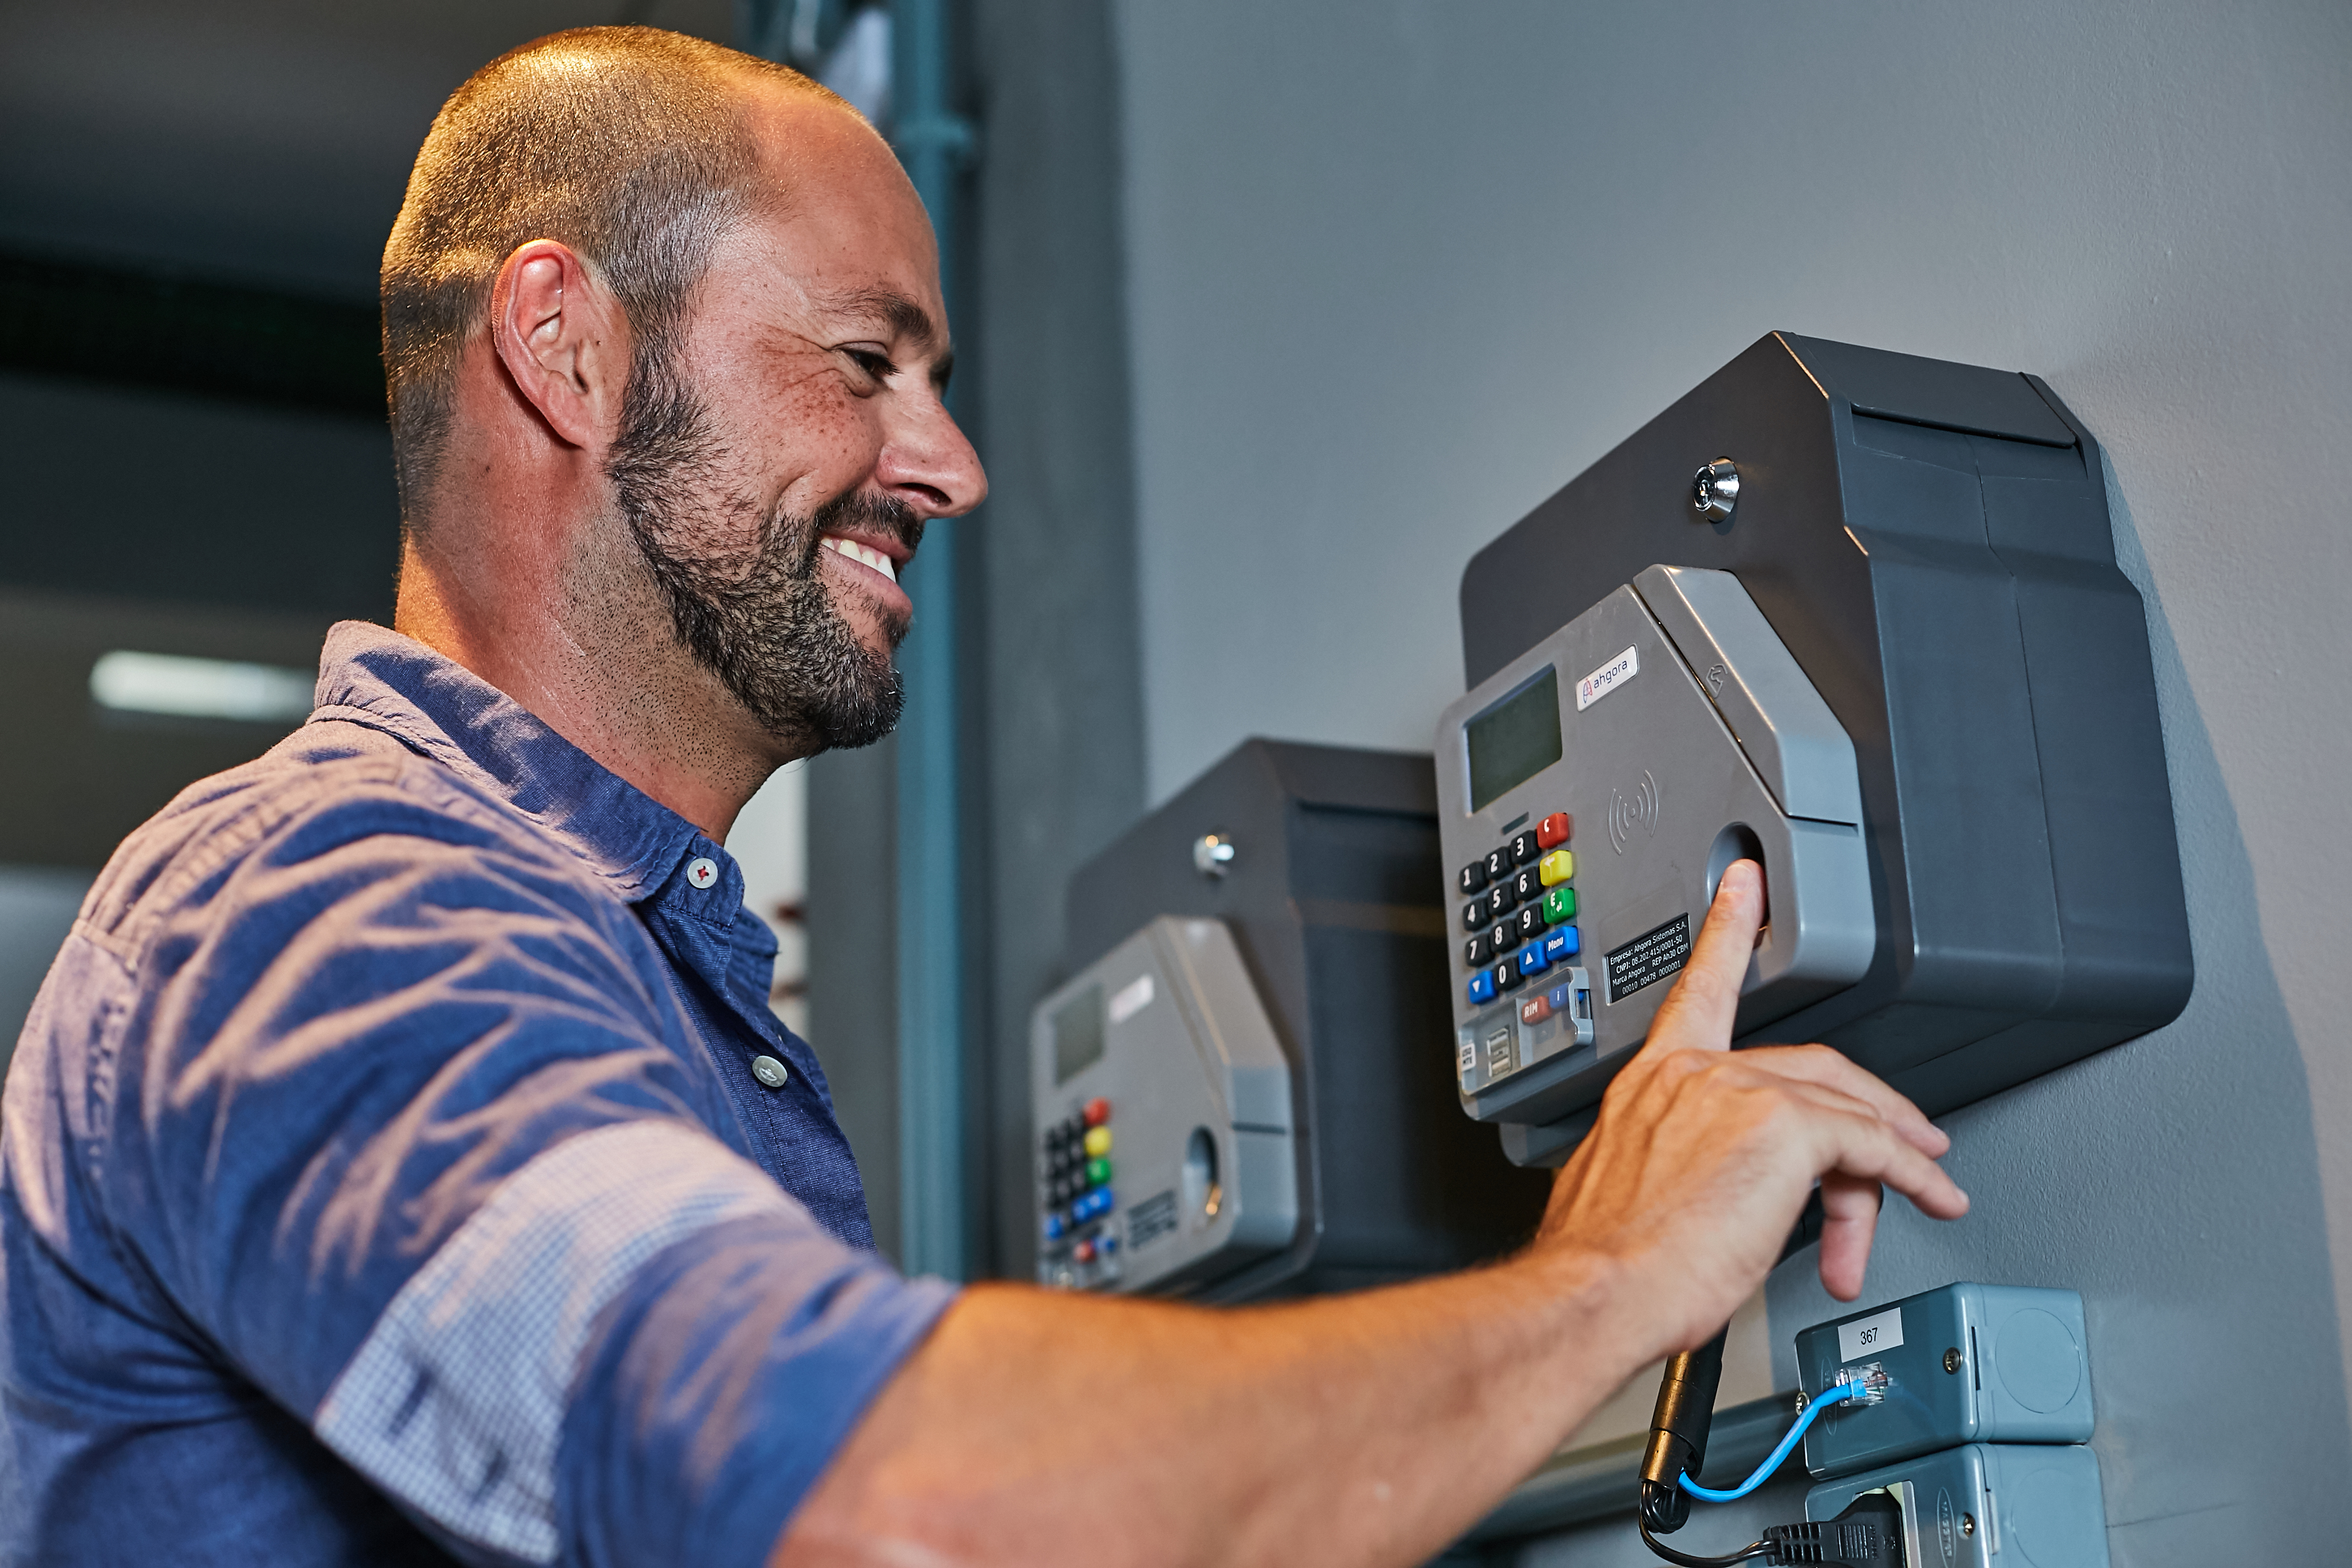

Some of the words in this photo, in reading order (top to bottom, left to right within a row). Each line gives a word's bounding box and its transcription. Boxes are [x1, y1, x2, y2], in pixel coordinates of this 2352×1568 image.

[1594, 660, 1627, 689] ahgora
[1544, 818, 1550, 833] C
[1516, 837, 1524, 856] 3
[1490, 853, 1498, 873] 2
[1463, 868, 1471, 887] 1
[1519, 874, 1528, 893] 6
[1493, 889, 1501, 909] 5
[1467, 904, 1476, 922] 4
[1523, 910, 1531, 930] 9
[1494, 926, 1503, 945] 8
[1548, 936, 1564, 951] Menu
[1610, 949, 1633, 966] Empresa:
[1634, 939, 1652, 953] Ahgora
[1652, 927, 1676, 944] Sistemas
[1676, 921, 1687, 932] S.A.
[1469, 940, 1477, 960] 7
[1616, 961, 1630, 974] CNPJ:
[1632, 934, 1683, 966] 08.202.415/0001-50
[1612, 975, 1627, 987] Marca
[1628, 966, 1646, 980] Ahgora
[1652, 956, 1662, 968] REP
[1663, 949, 1676, 962] Ah30
[1677, 942, 1689, 954] CBM
[1499, 965, 1507, 984] 0
[1622, 981, 1638, 995] 00010
[1640, 972, 1656, 986] 00478
[1524, 1001, 1538, 1018] RIM
[1860, 1327, 1878, 1345] 367
